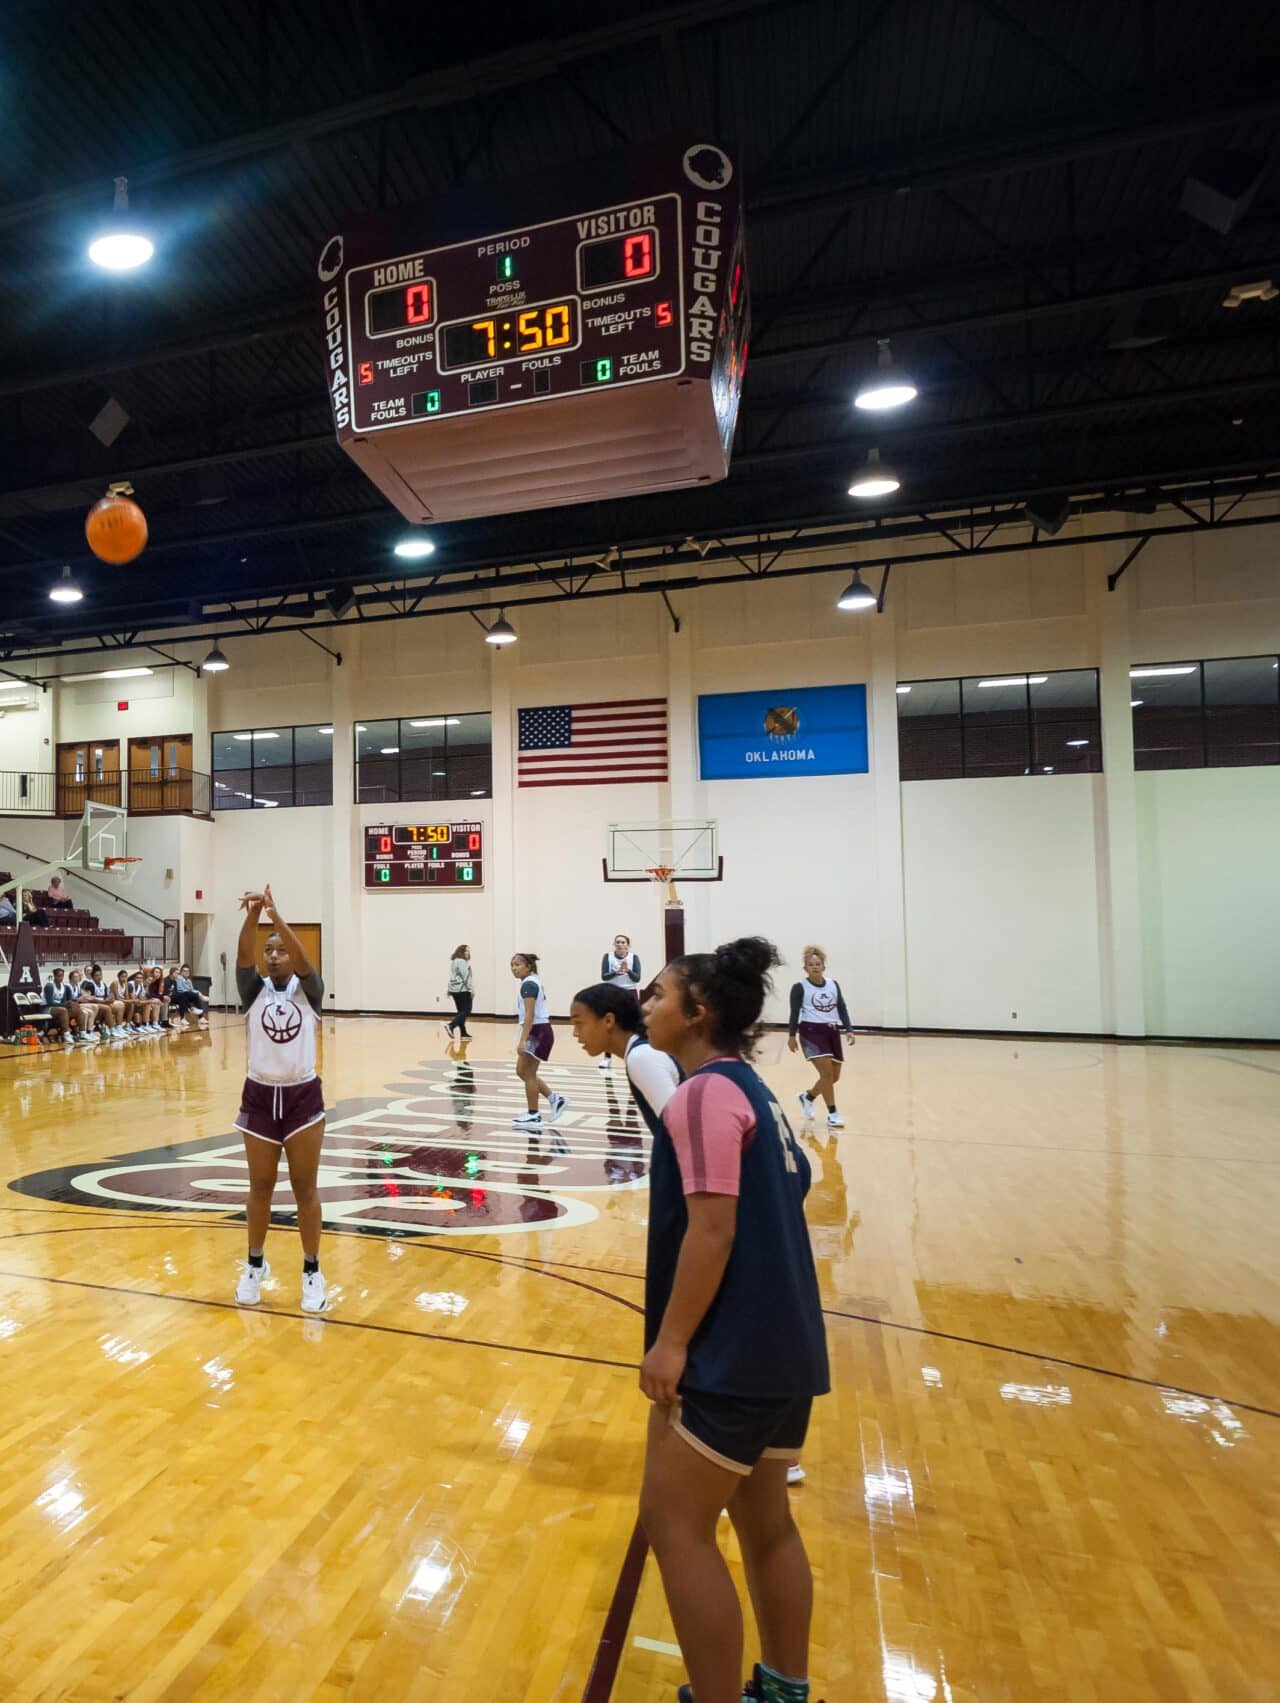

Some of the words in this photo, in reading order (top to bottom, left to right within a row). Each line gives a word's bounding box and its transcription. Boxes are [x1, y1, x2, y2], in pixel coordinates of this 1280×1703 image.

[576, 205, 656, 240] VISITOR
[477, 236, 531, 257] PERIOD
[624, 234, 651, 278] 0
[373, 259, 425, 286] HOME
[504, 256, 511, 277] 1
[489, 280, 521, 294] POSS
[688, 201, 722, 362] COUGARS
[405, 283, 430, 325] 0
[582, 293, 626, 310] BONUS
[586, 307, 652, 329] TIMEOUTS
[657, 303, 672, 326] 5
[471, 305, 570, 357] 7:50
[601, 322, 635, 336] LEFT
[396, 333, 434, 349] BONUS
[323, 287, 350, 429] COUGARS
[376, 351, 433, 370] TIMEOUTS
[521, 356, 562, 371] FOULS
[621, 350, 660, 365] TEAM
[360, 363, 372, 383] 5
[390, 363, 419, 377] LEFT
[460, 367, 505, 383] PLAYER
[596, 359, 611, 381] 0
[619, 361, 662, 376] FOULS
[372, 398, 405, 411] TEAM
[426, 390, 439, 412] 0
[370, 408, 407, 421] FOULS
[745, 749, 816, 763] OKLAHOMA
[407, 826, 448, 842] 7:50
[451, 824, 481, 832] VISITOR
[380, 836, 391, 852] 0
[468, 834, 480, 850] 0
[380, 869, 390, 881] 0
[463, 867, 473, 880] 0
[20, 966, 33, 983] A
